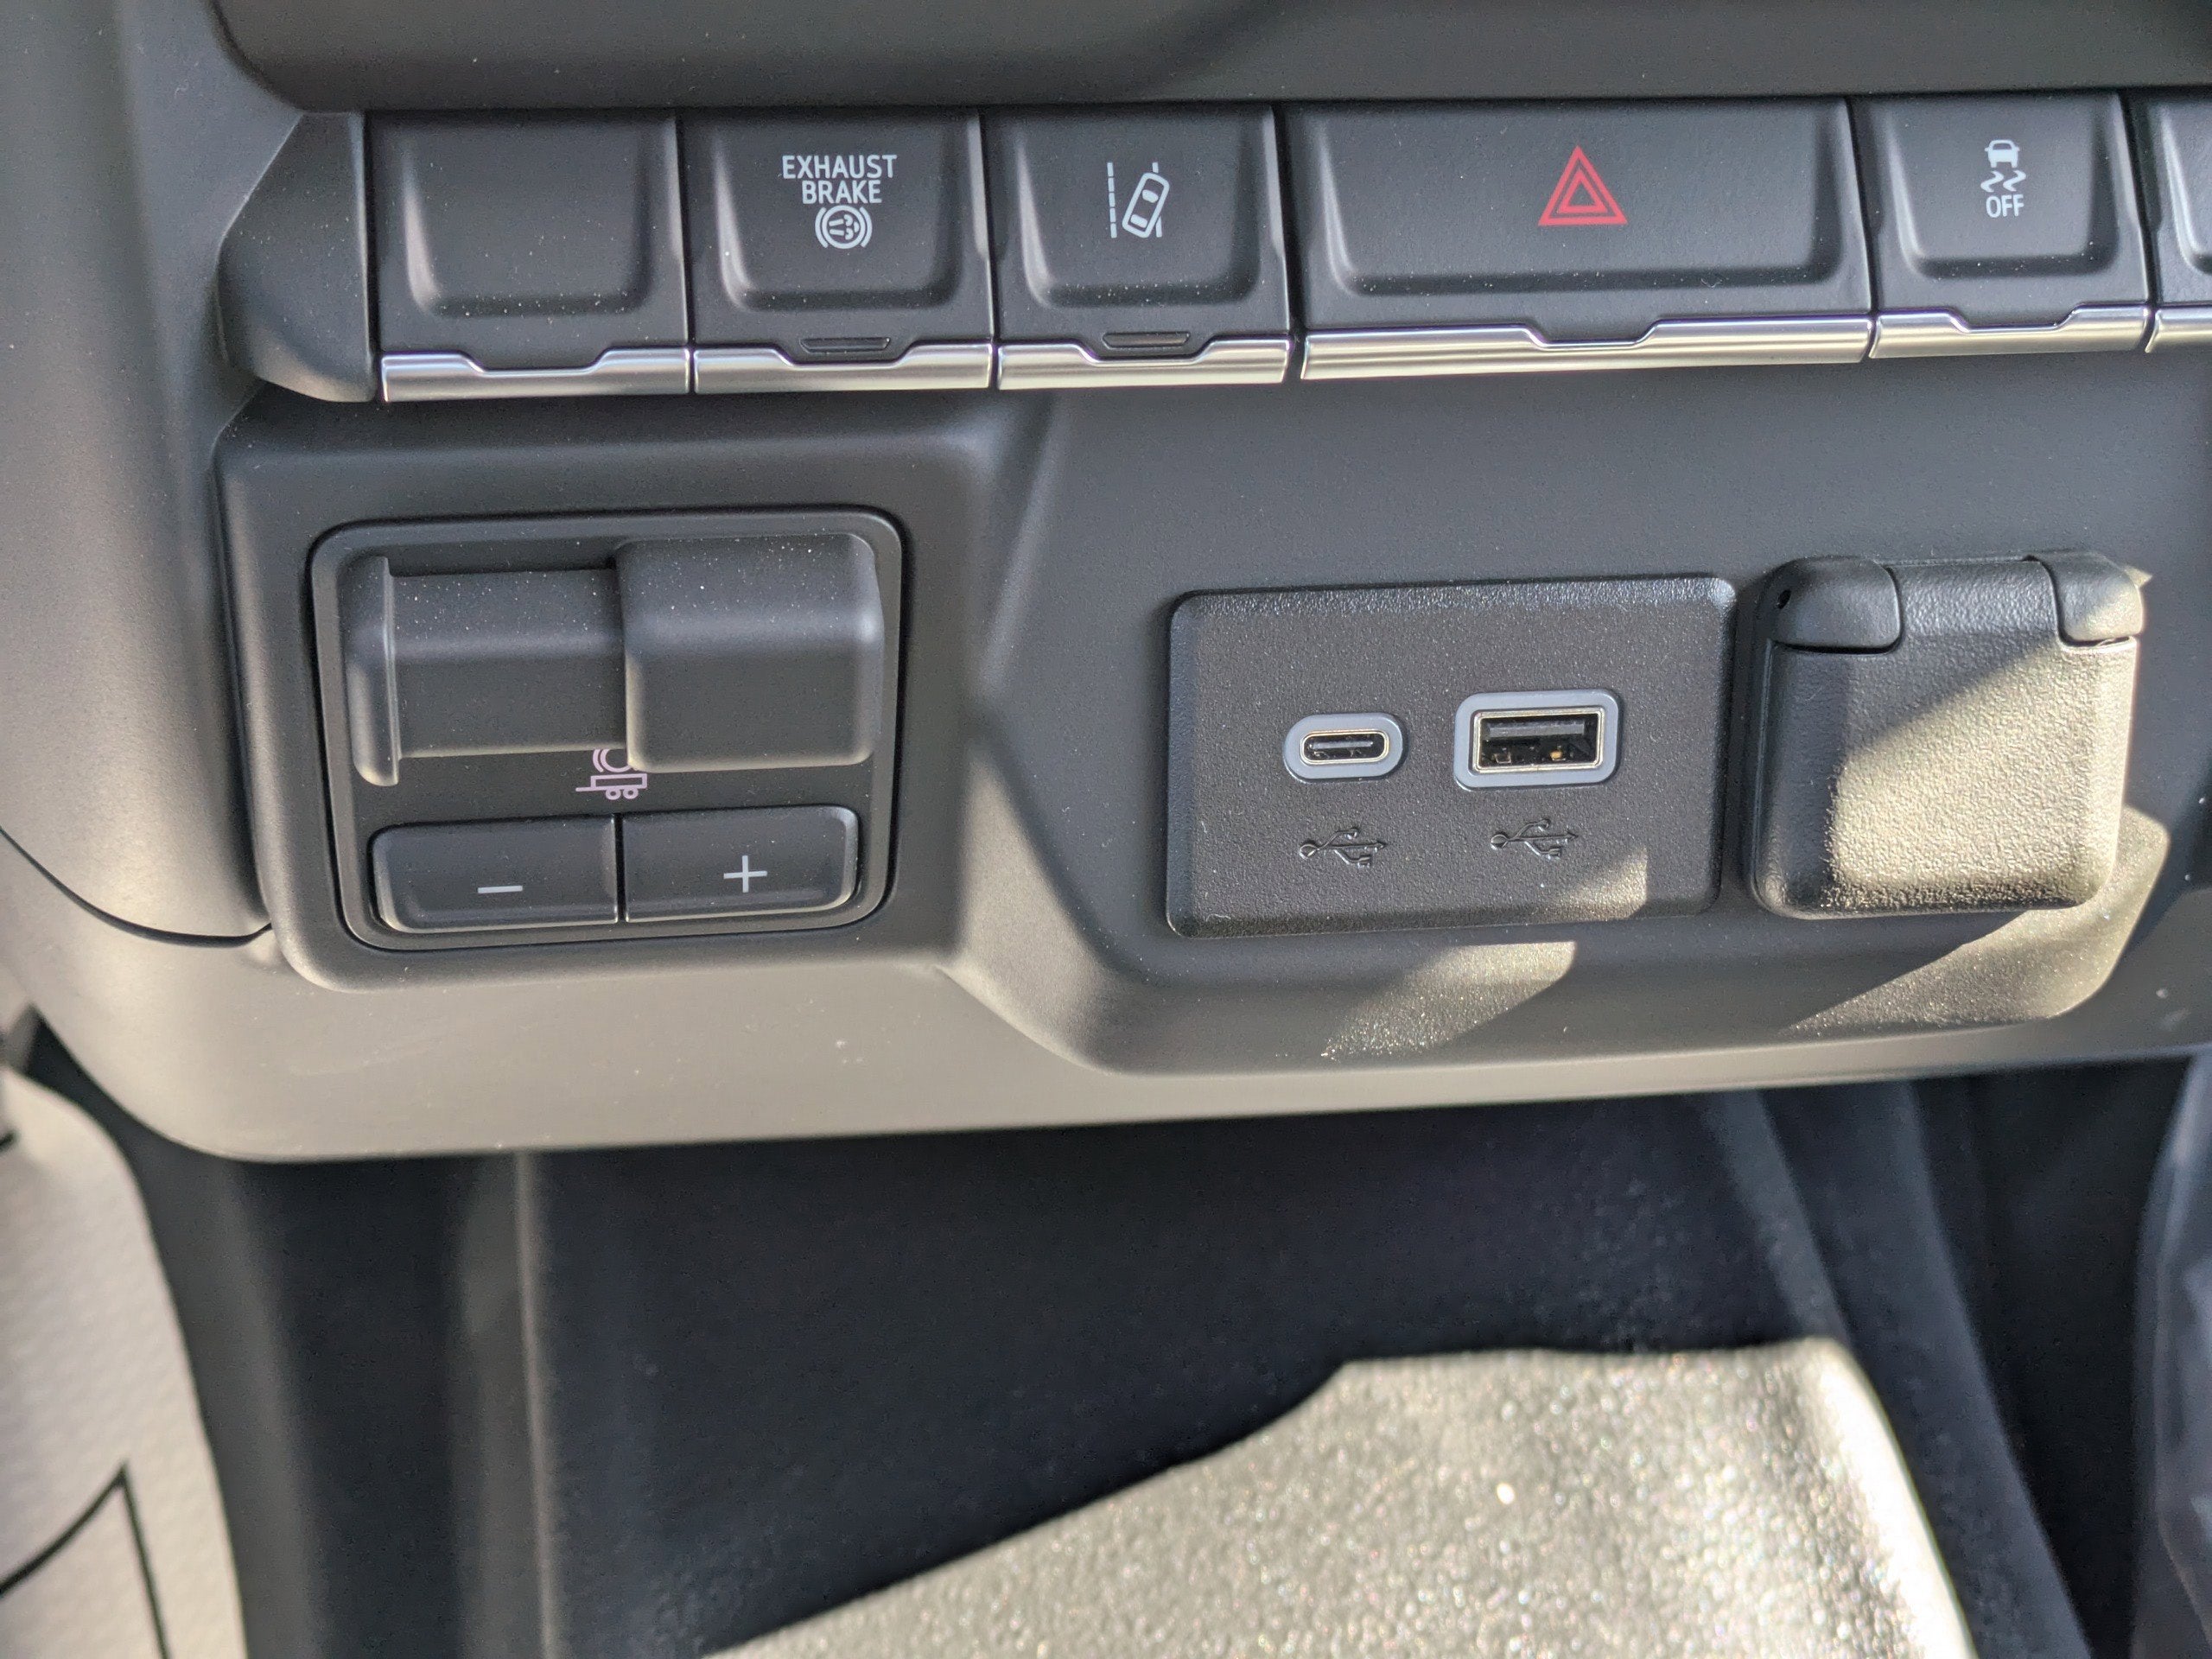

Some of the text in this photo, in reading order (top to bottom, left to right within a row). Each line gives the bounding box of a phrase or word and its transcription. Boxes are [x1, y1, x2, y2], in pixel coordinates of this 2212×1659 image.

[782, 154, 898, 179] EXHAUST
[802, 180, 882, 204] BRAKE
[1986, 194, 2024, 218] OFF
